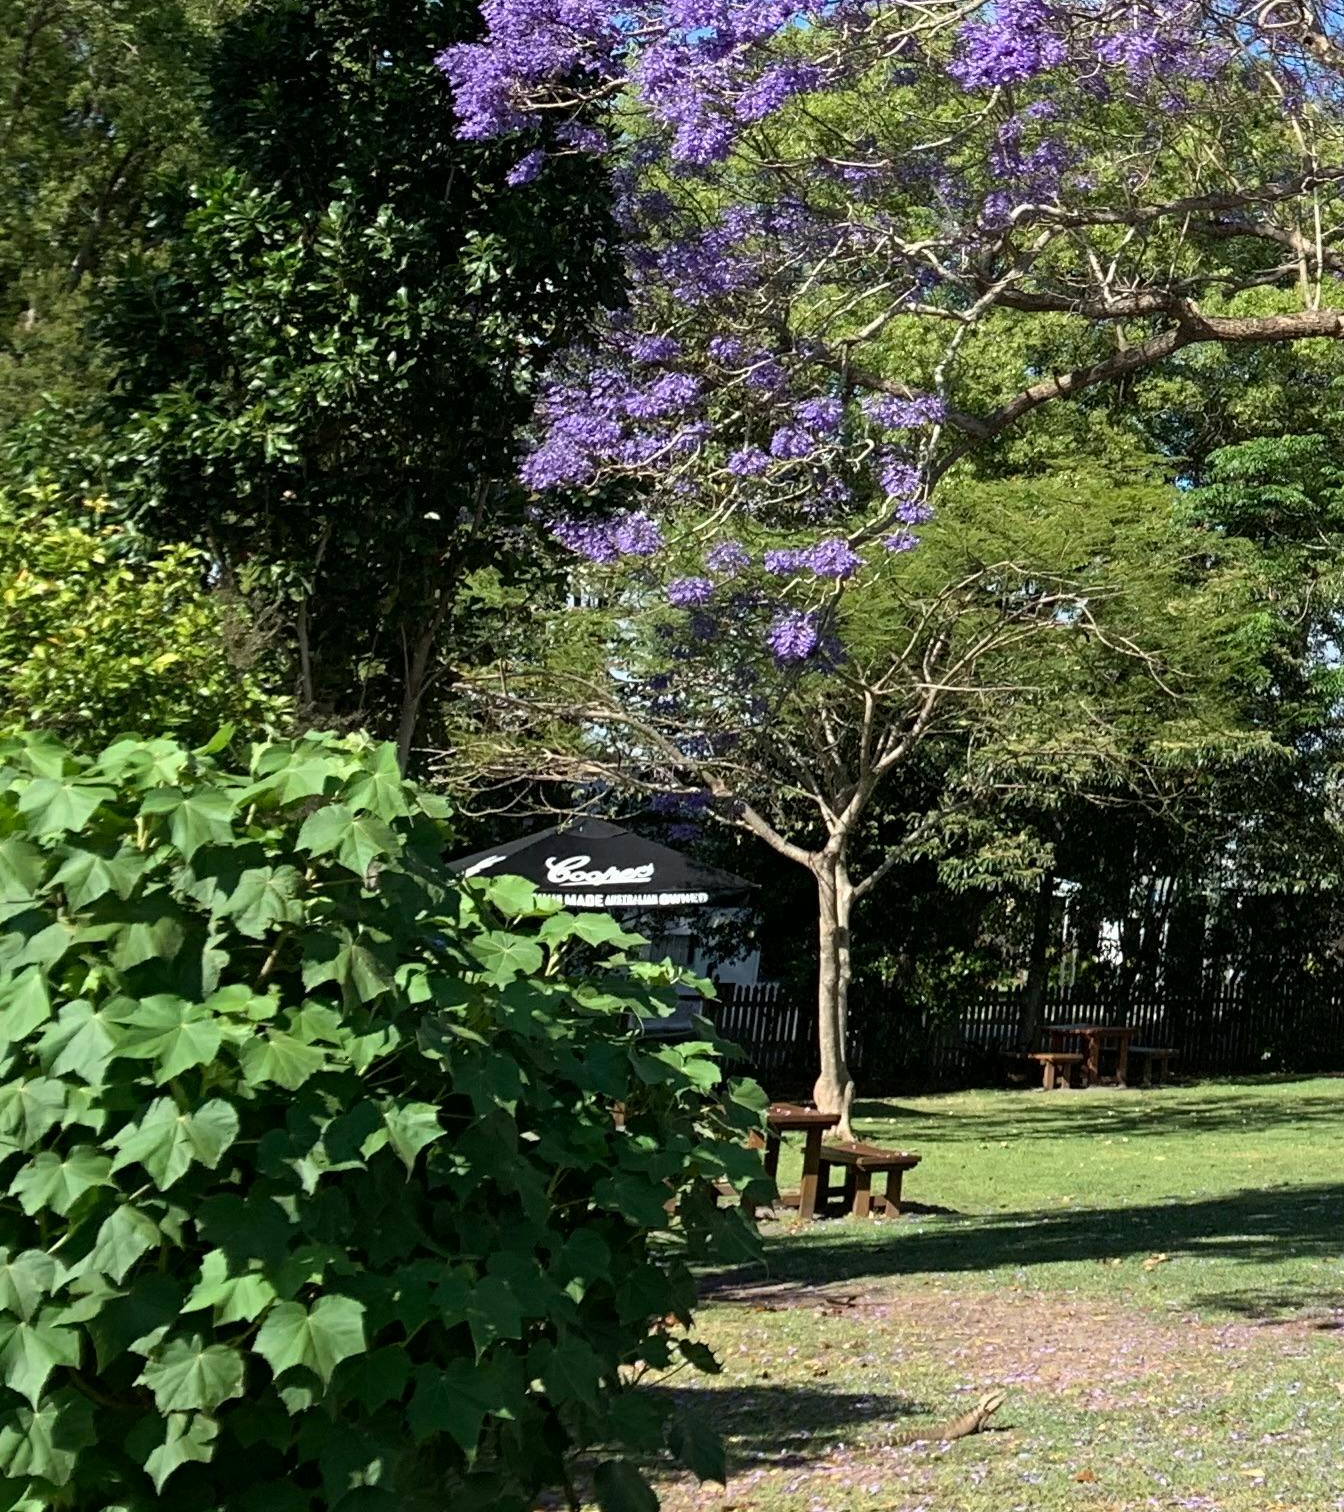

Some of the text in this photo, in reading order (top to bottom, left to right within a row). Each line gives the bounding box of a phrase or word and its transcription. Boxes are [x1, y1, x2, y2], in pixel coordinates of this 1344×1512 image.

[545, 855, 654, 885] Coopers
[565, 893, 604, 907] MADE
[604, 893, 658, 906] AUSTRALIAN
[658, 892, 708, 906] OWNED
